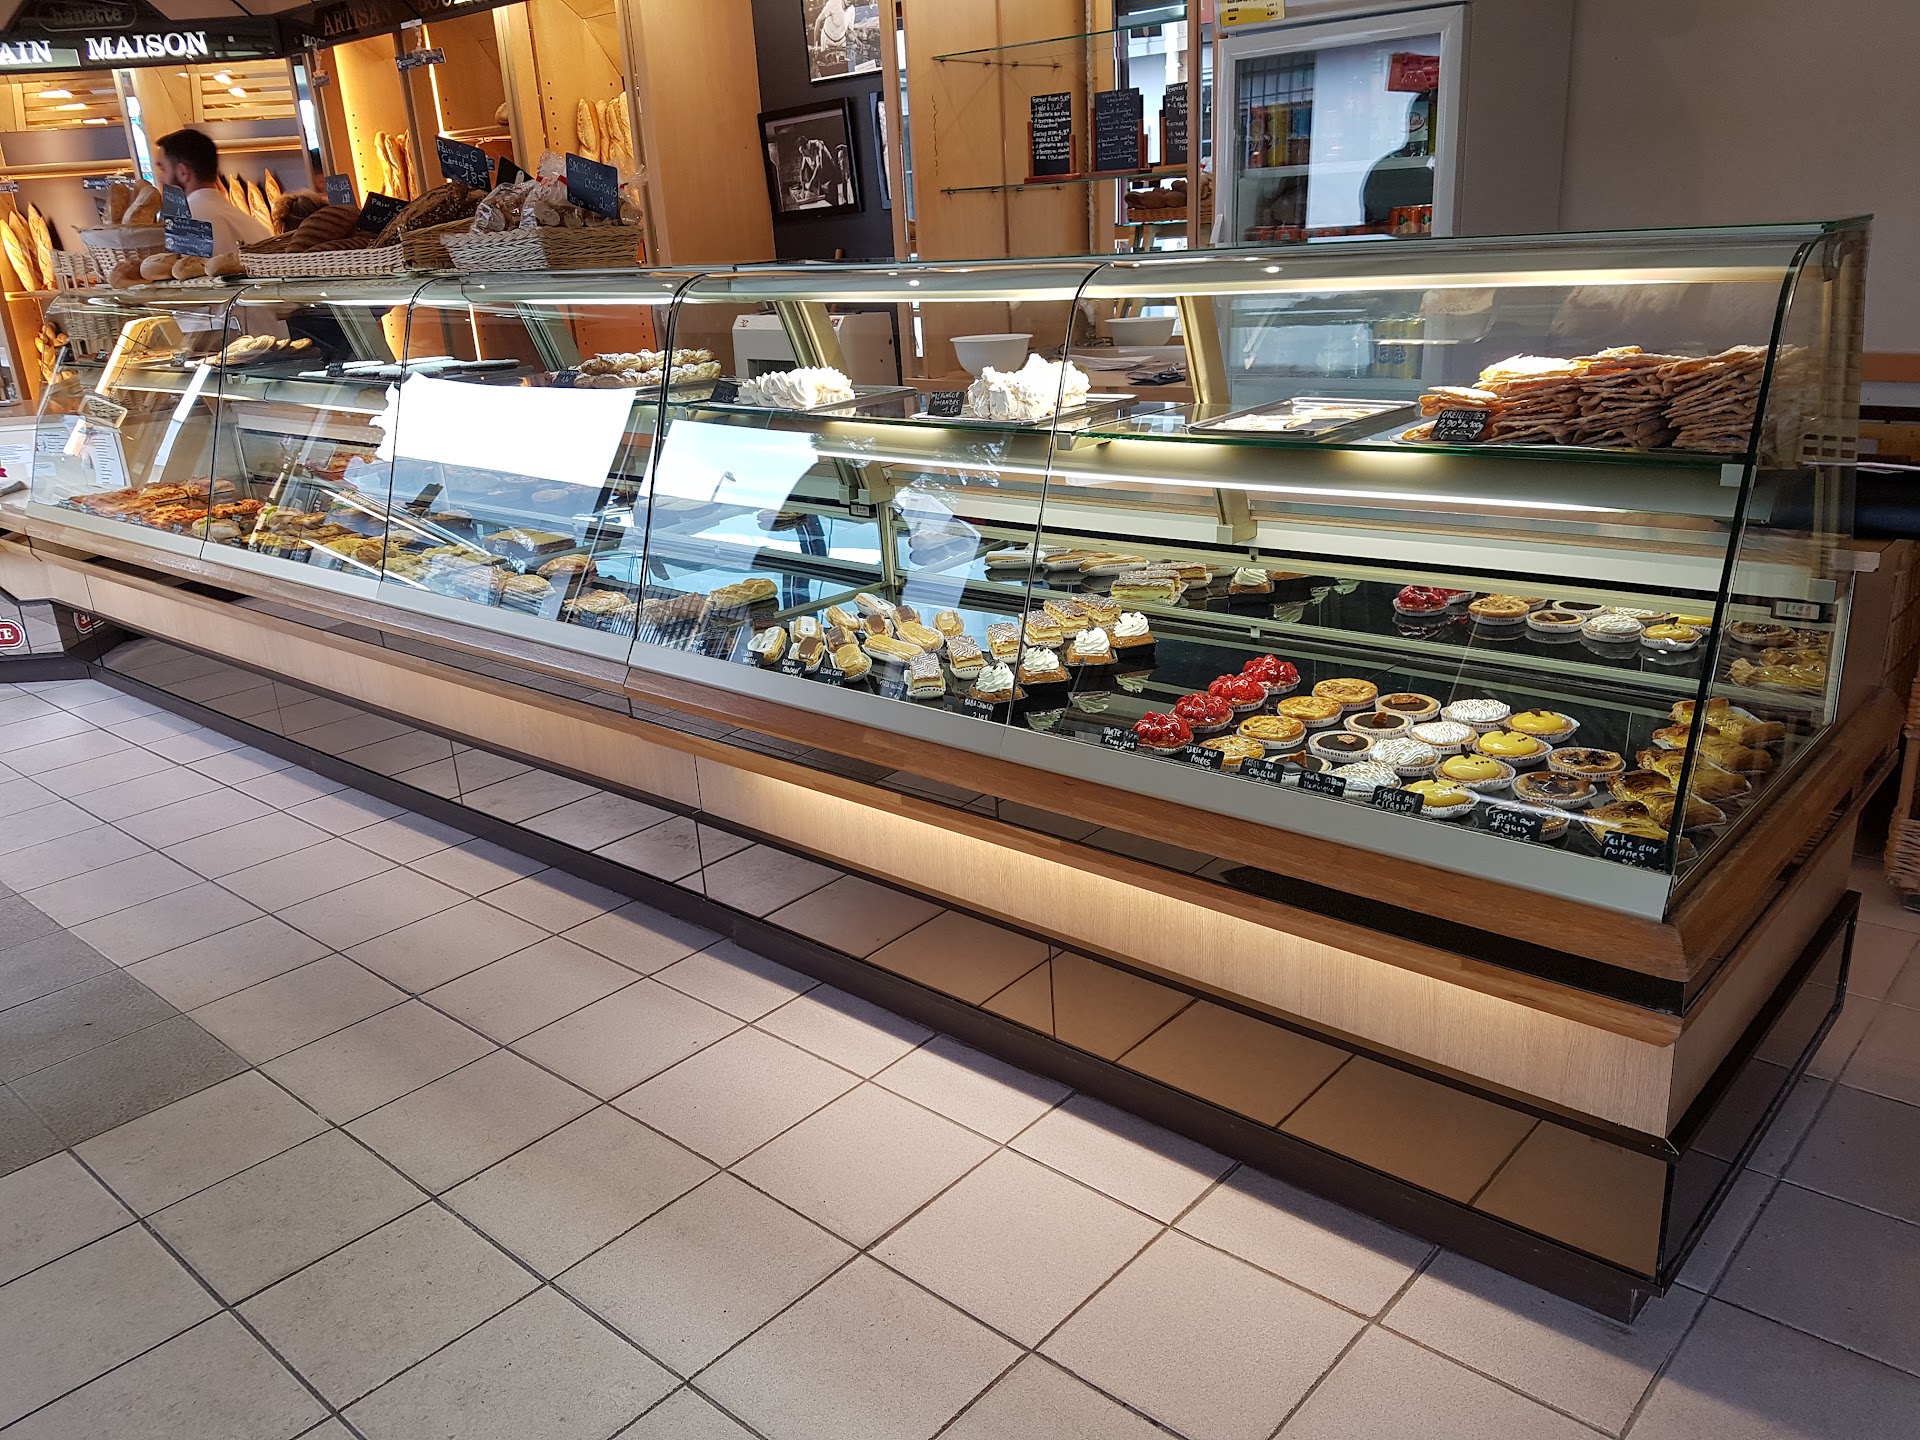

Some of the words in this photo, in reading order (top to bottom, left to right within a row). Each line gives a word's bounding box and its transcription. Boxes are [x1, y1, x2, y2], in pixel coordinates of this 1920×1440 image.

[85, 31, 209, 61] MAISON
[469, 150, 478, 163] 6
[1519, 817, 1536, 827] aux
